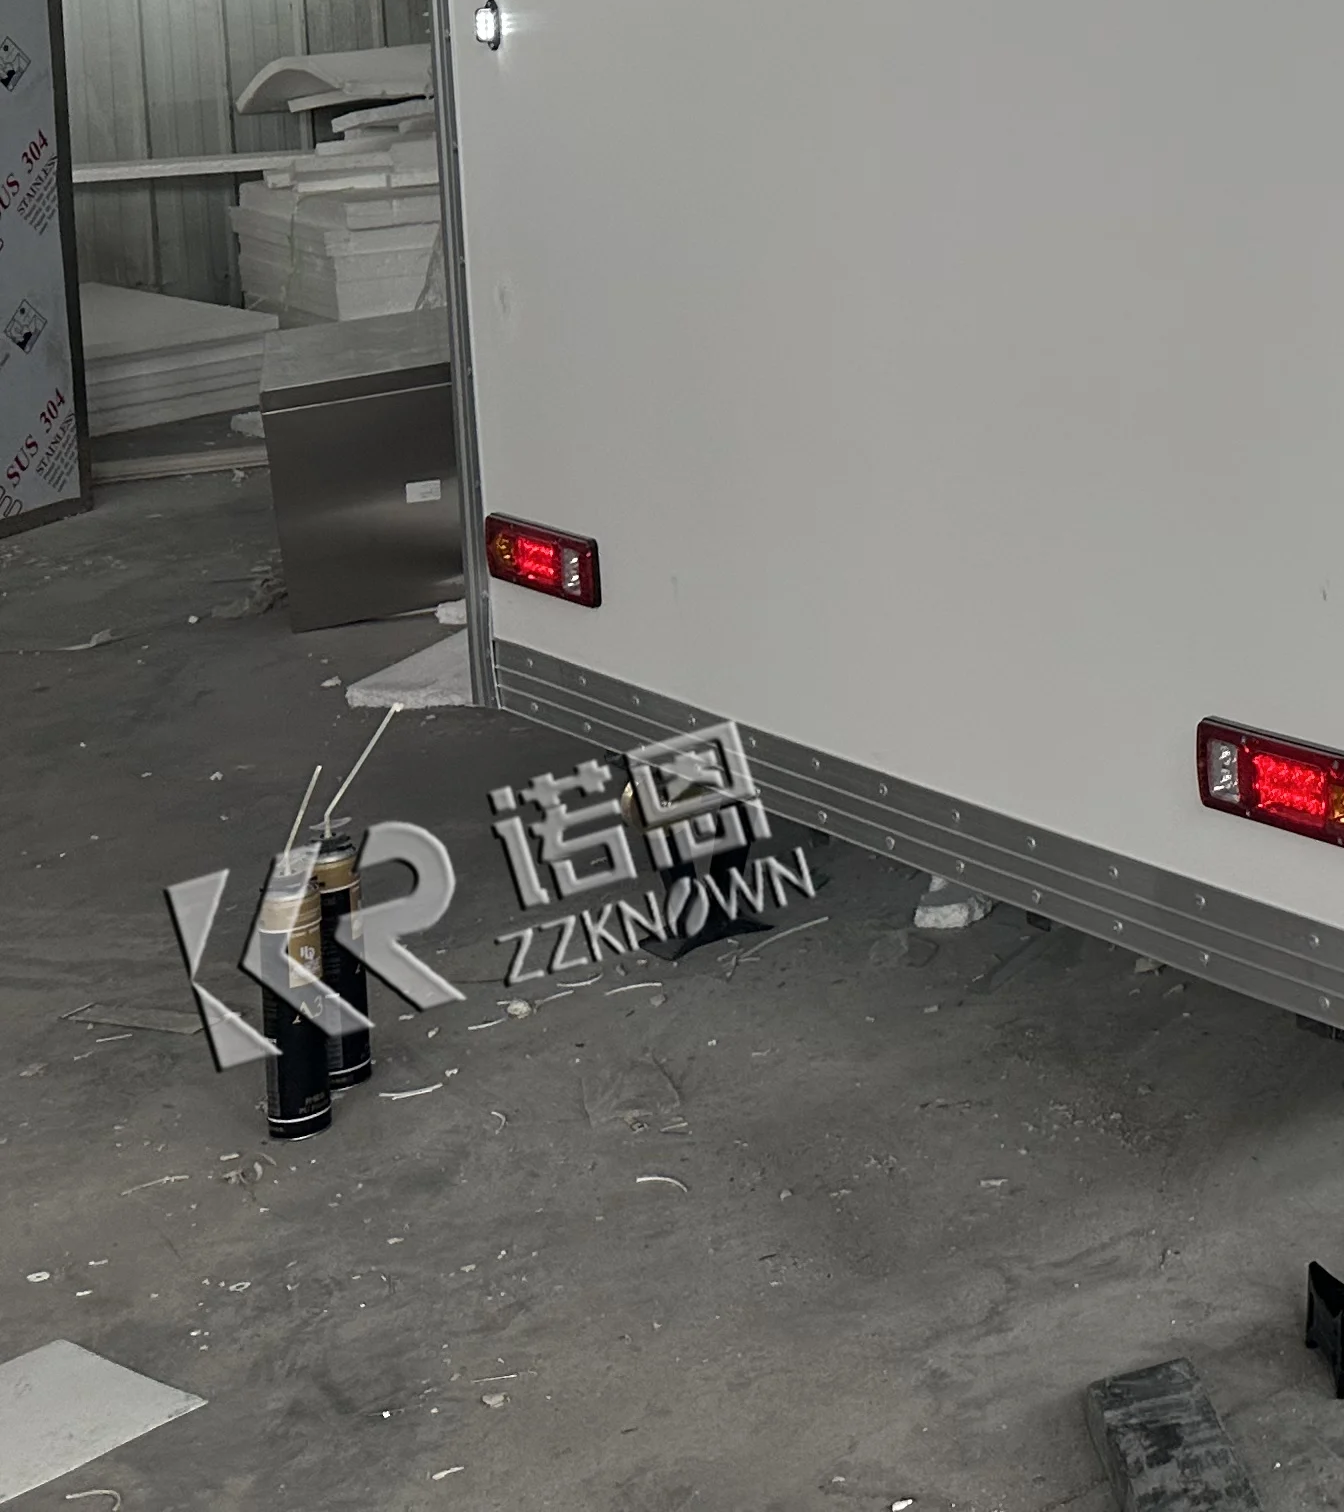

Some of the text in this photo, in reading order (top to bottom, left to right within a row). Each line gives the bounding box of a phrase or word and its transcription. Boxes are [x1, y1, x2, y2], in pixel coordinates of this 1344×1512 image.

[0, 172, 20, 219] US
[21, 128, 49, 175] 304
[6, 433, 39, 489] SUS
[39, 387, 66, 435] 304
